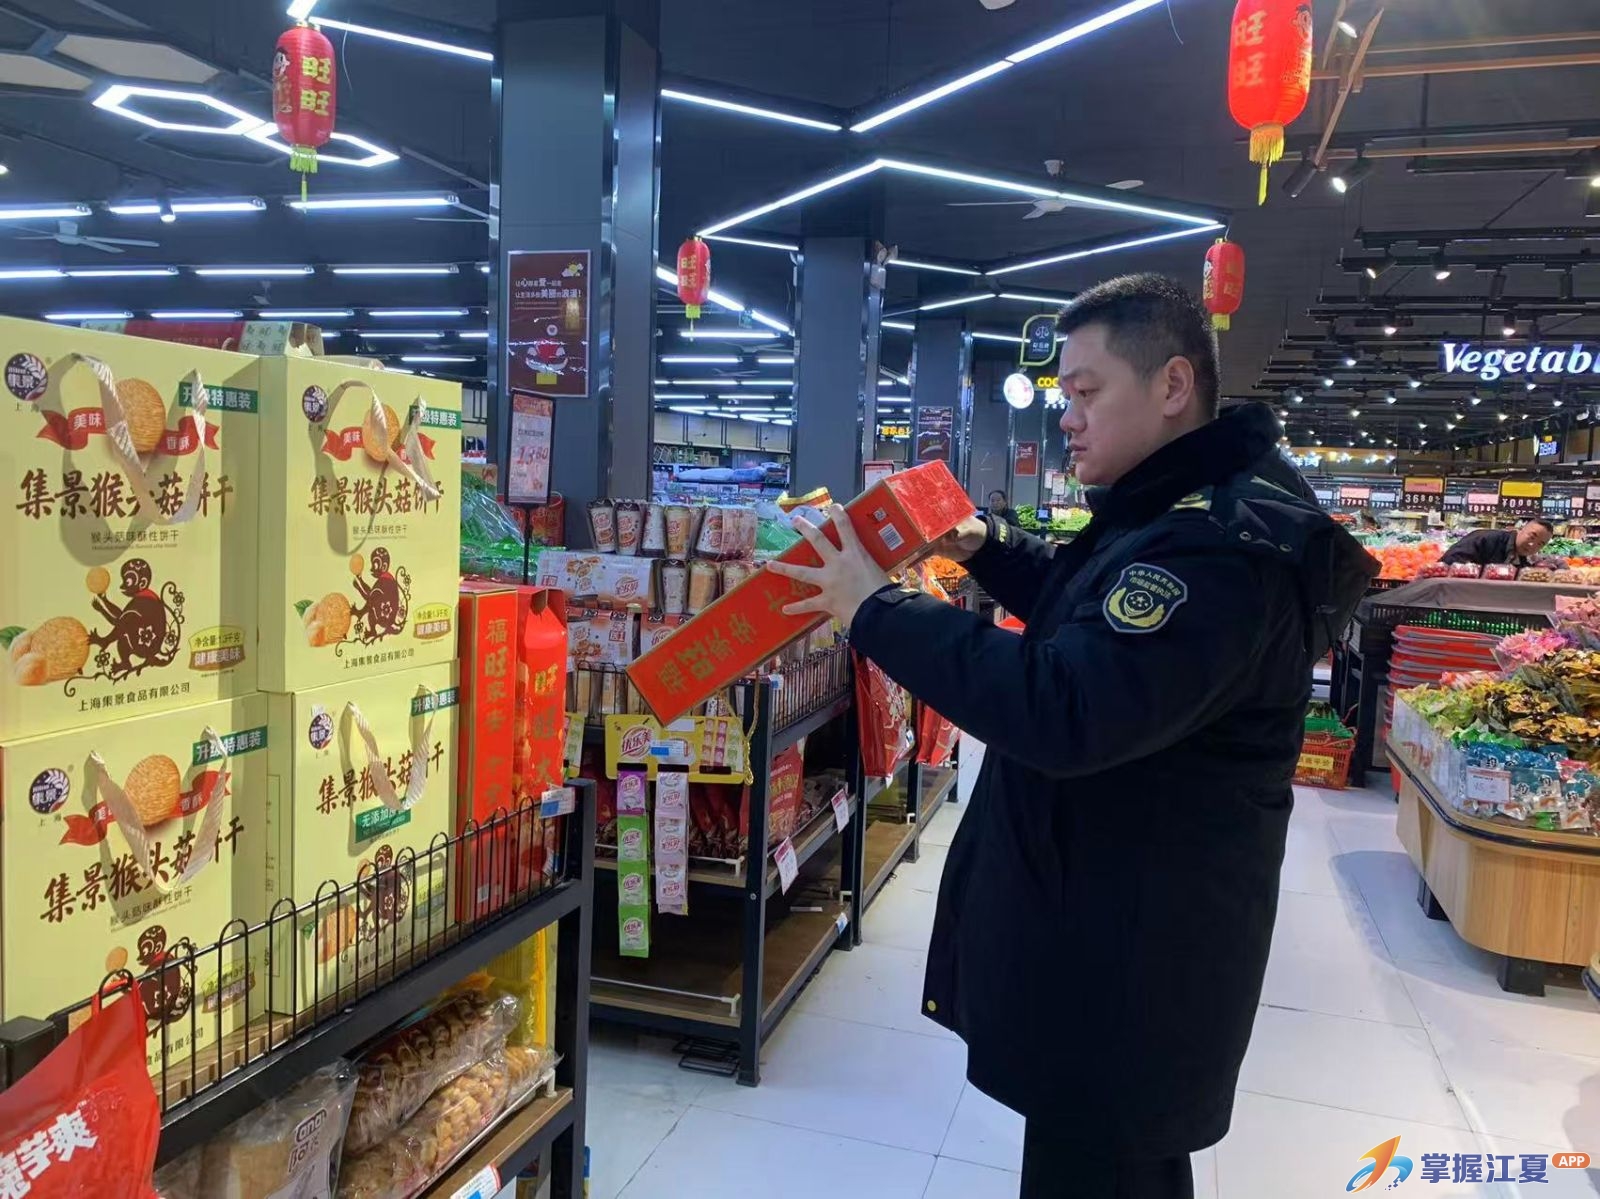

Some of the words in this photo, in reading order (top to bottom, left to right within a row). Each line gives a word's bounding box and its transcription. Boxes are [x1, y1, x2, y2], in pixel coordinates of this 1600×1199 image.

[1235, 10, 1267, 87] 旺旺
[300, 55, 332, 117] 旺旺
[73, 413, 102, 431] 美味
[78, 682, 190, 713] 上海集景食品有限公司
